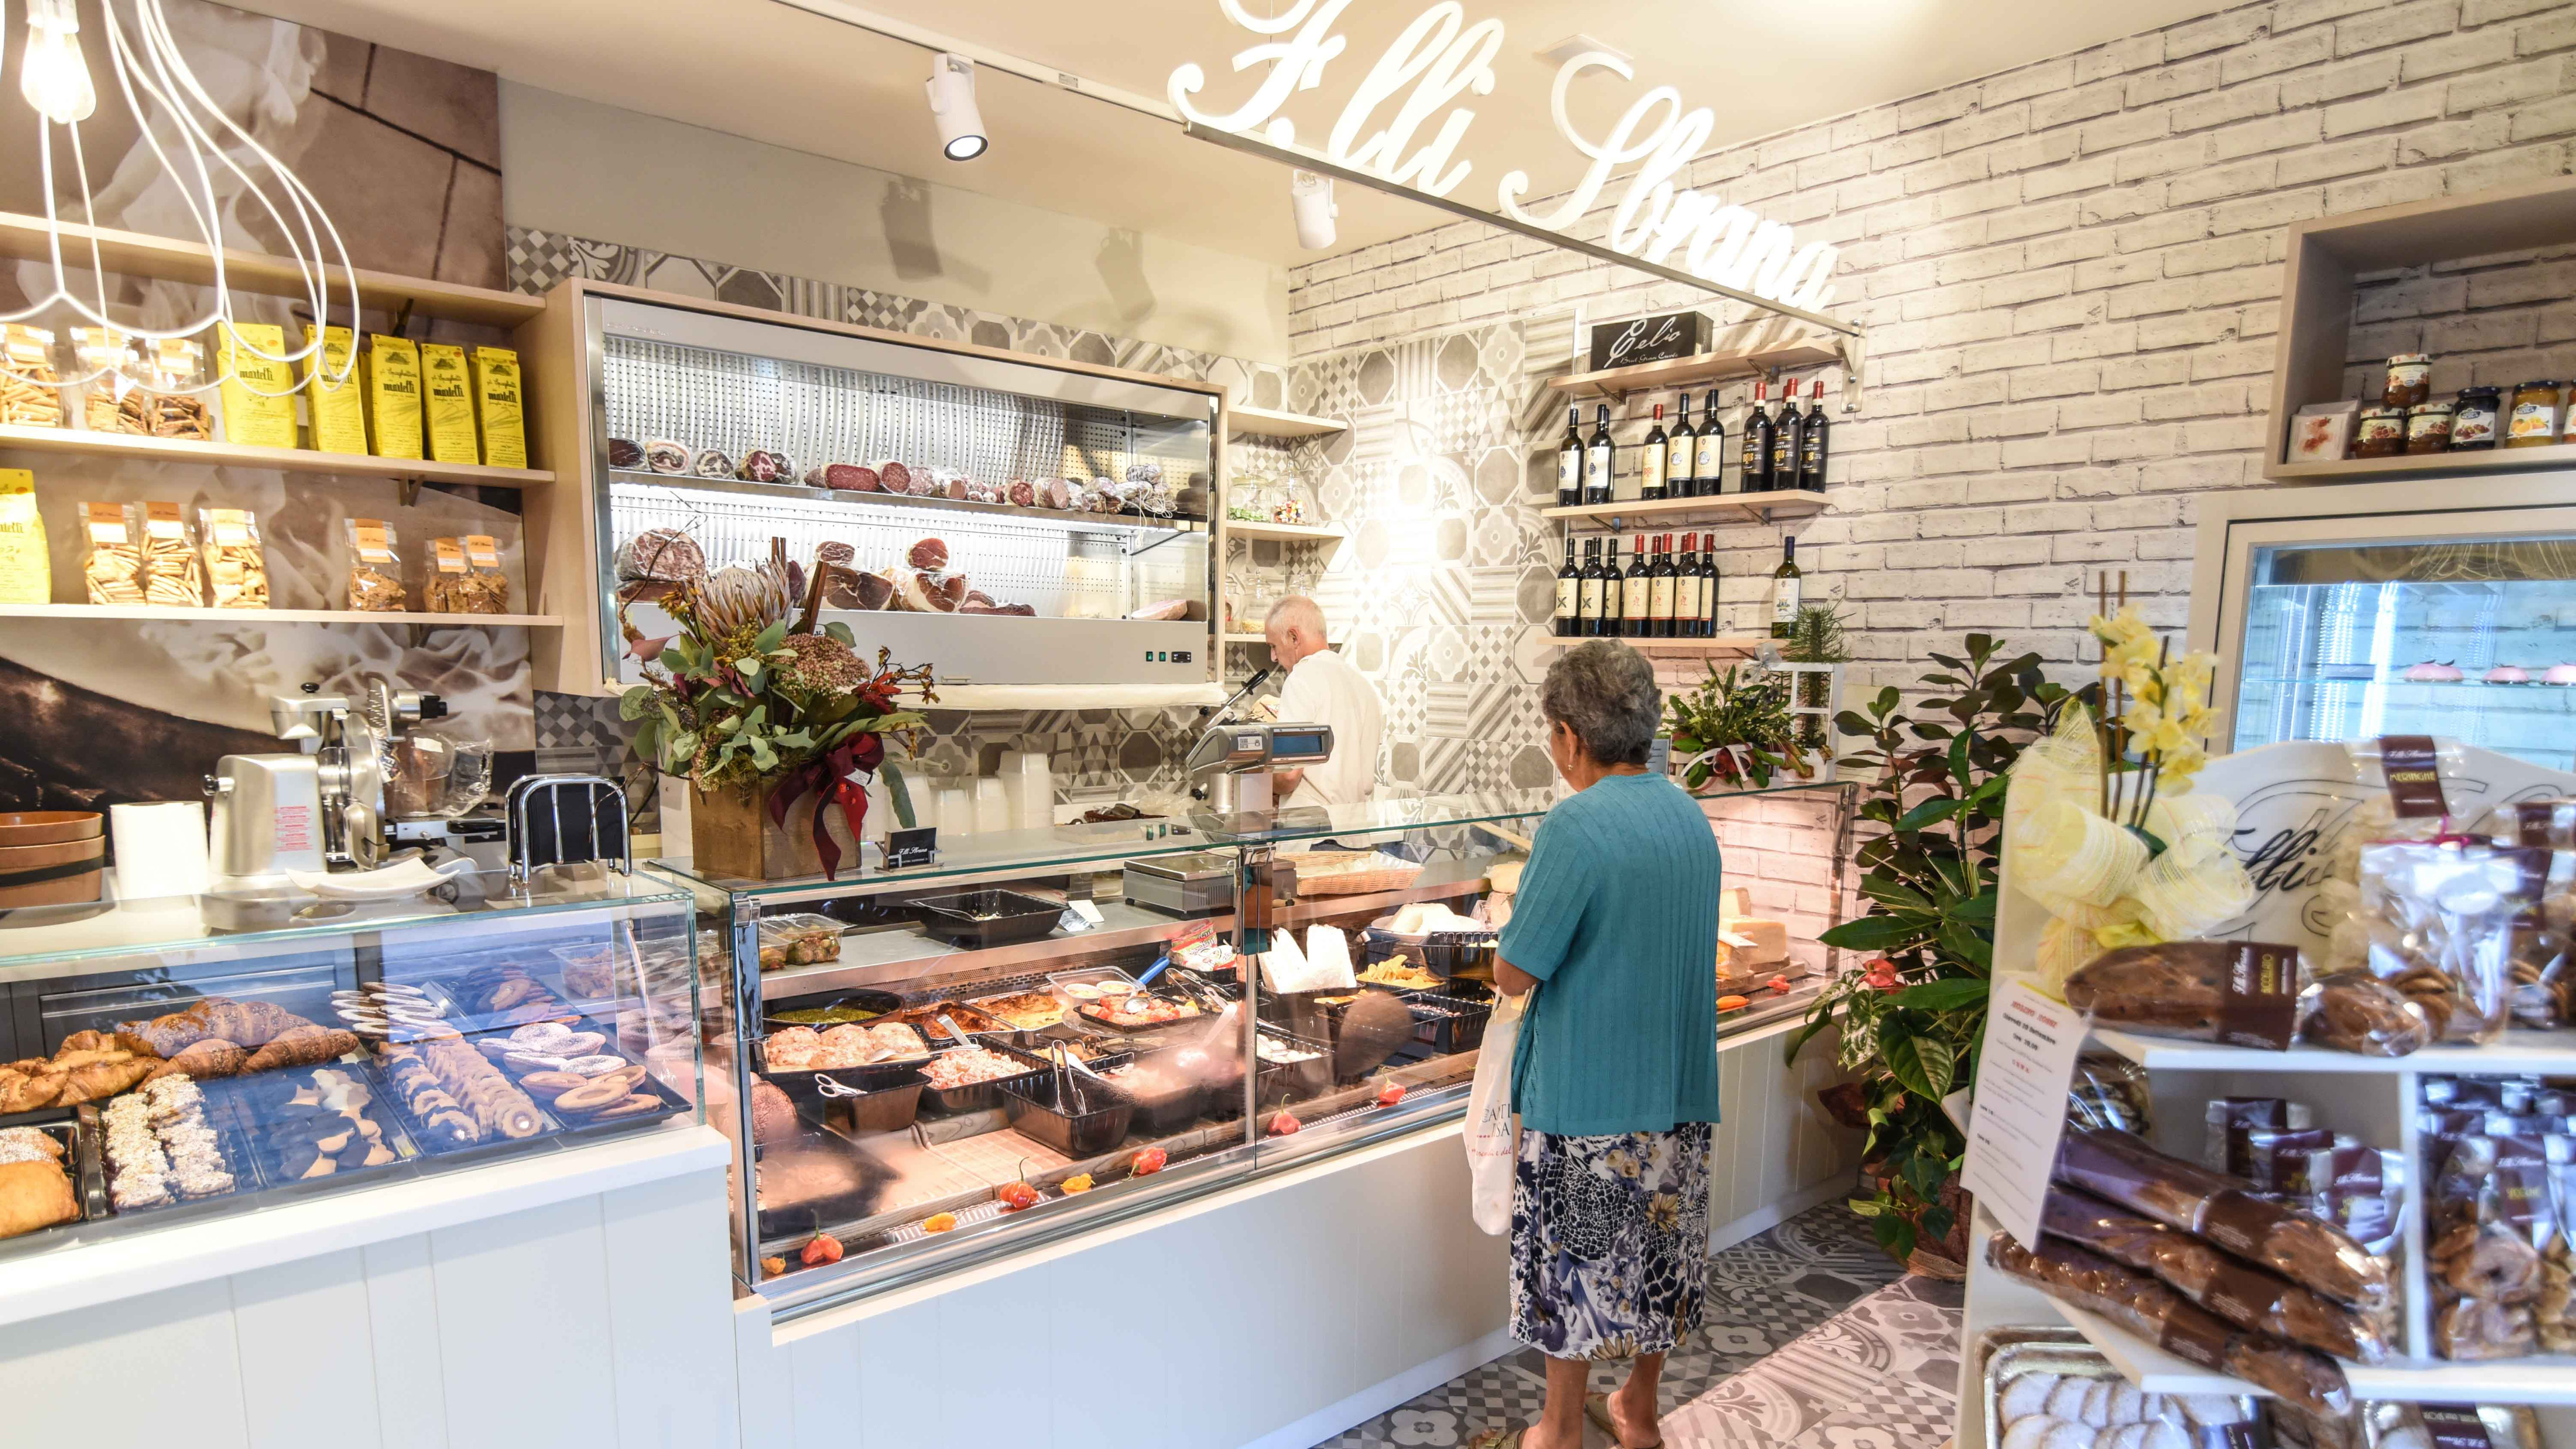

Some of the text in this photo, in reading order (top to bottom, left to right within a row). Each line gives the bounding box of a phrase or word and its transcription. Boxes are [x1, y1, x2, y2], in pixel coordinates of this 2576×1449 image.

[1620, 356, 1637, 364] Brut
[240, 368, 274, 381] martelli
[383, 380, 416, 394] martelli
[433, 384, 465, 398] martelli
[488, 391, 518, 404] martelli
[0, 522, 24, 533] rtelli
[2389, 771, 2435, 781] MERINGHE
